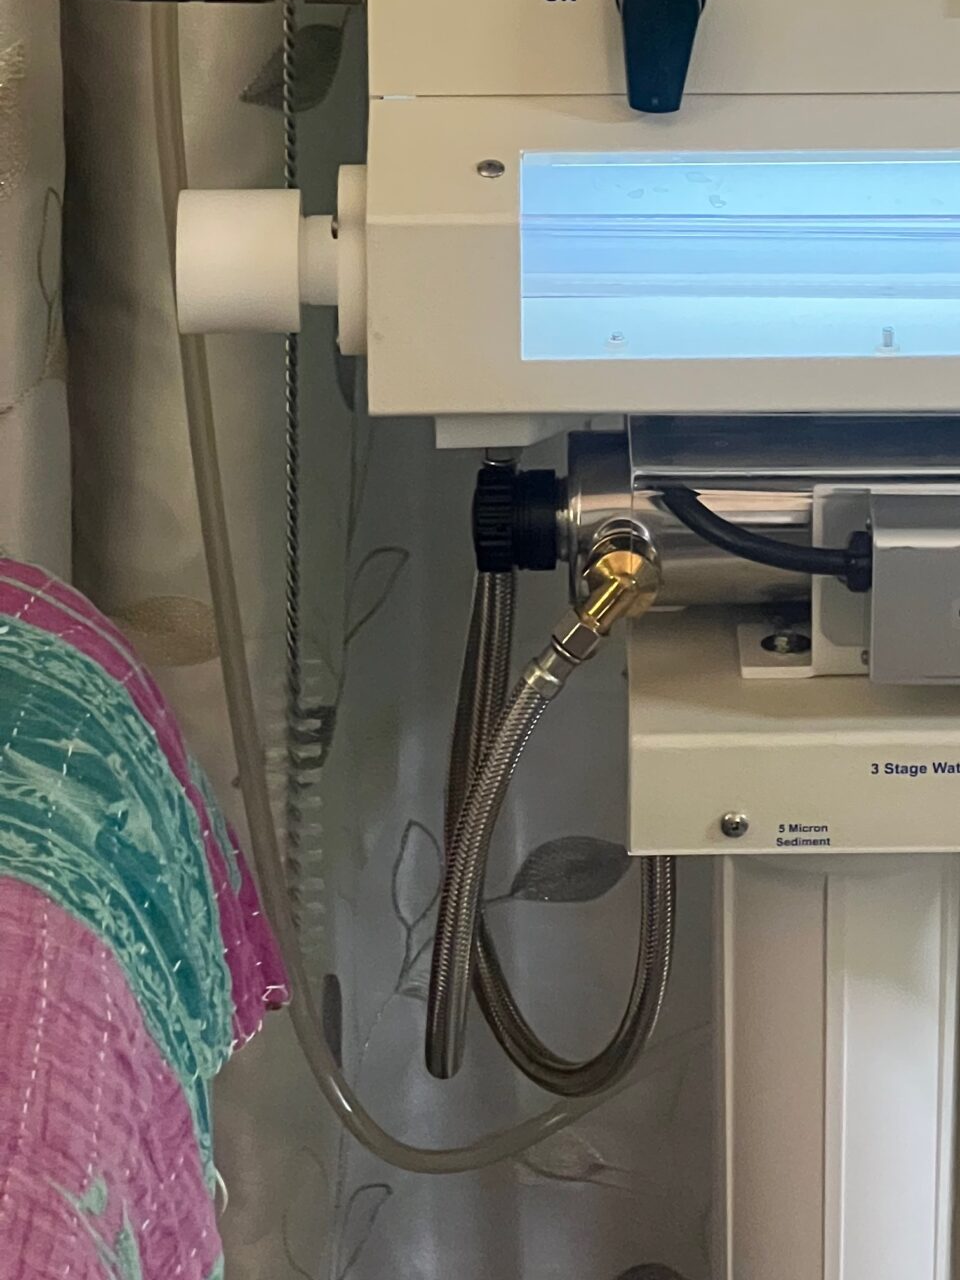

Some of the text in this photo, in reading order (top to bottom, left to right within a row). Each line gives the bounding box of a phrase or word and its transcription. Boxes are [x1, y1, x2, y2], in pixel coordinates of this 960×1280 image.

[871, 764, 879, 774] 3
[884, 763, 927, 777] Stage
[779, 824, 828, 833] 5 Micron
[776, 837, 831, 846] Sediment
